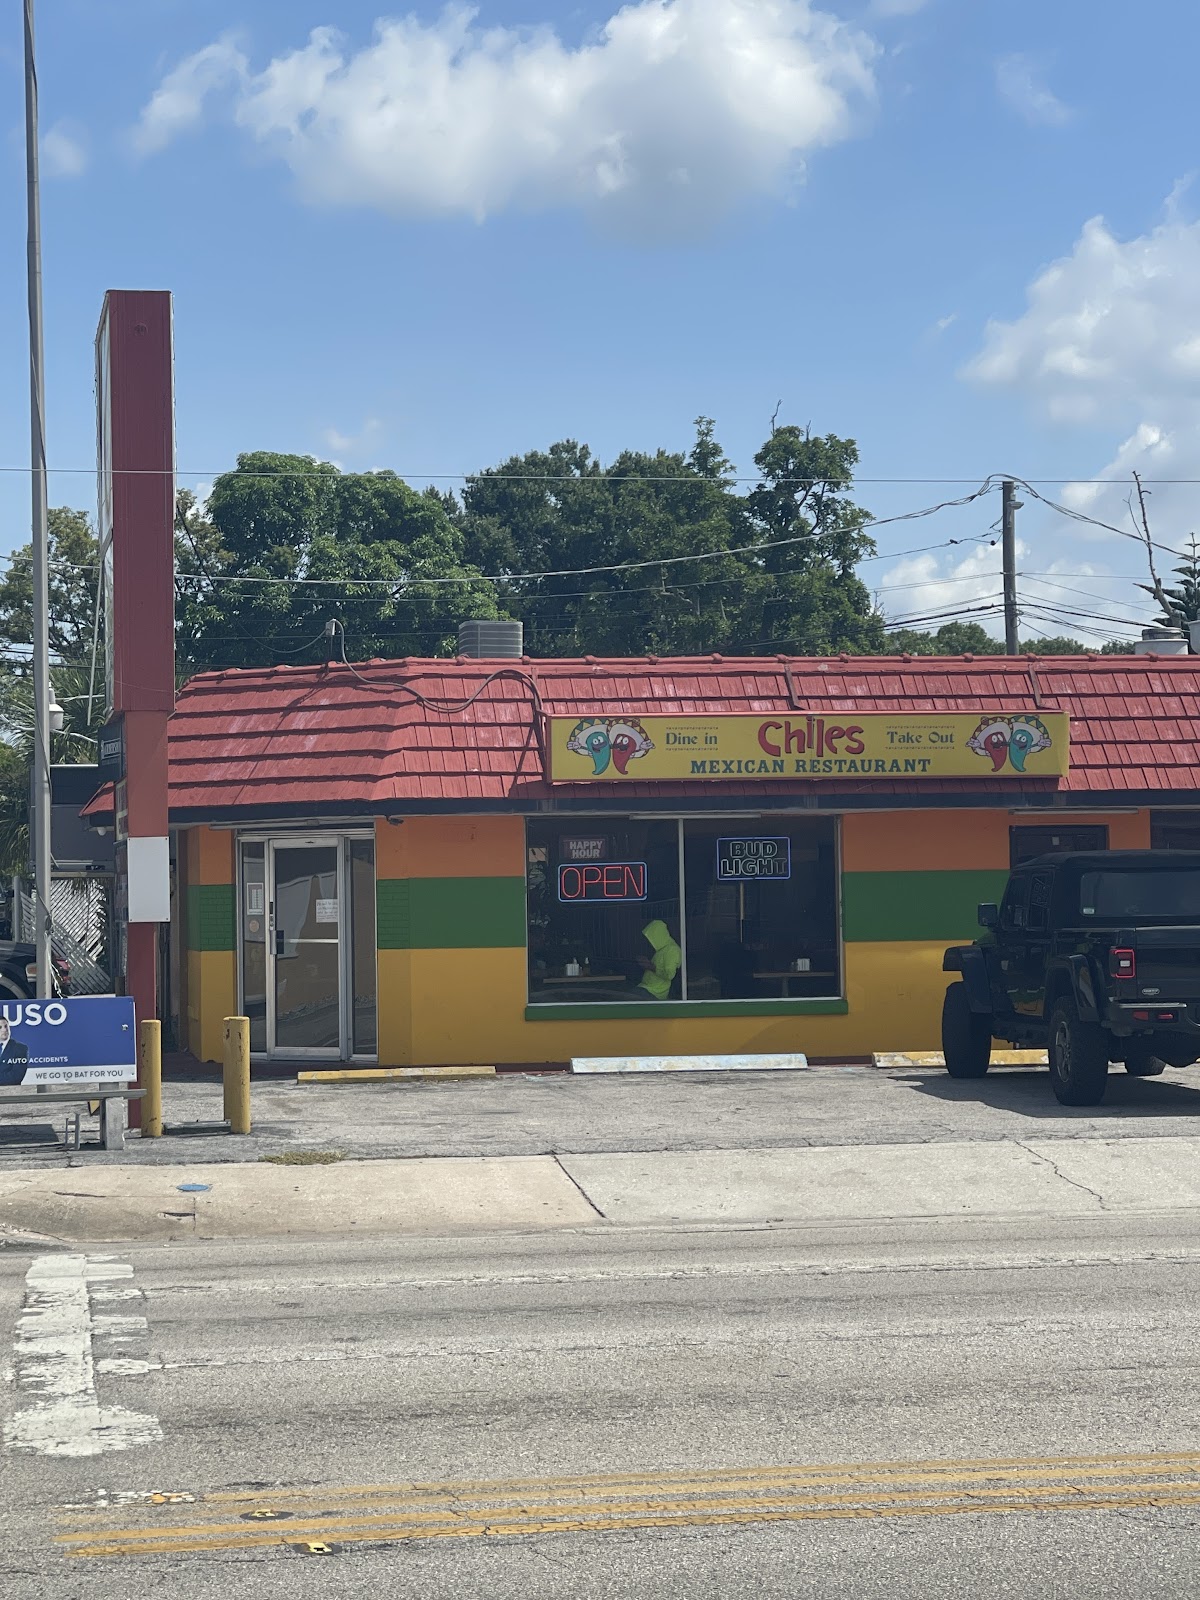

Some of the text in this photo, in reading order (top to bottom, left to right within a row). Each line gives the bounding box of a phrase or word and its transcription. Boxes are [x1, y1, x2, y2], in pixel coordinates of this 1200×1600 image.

[665, 731, 718, 746] Dine in
[757, 715, 865, 757] Chiles
[886, 731, 955, 744] Take Out
[690, 758, 931, 774] MEXICAN RESTAURANT
[569, 840, 603, 850] HAPPY
[729, 841, 778, 858] BUD
[572, 849, 600, 859] HOUR
[720, 858, 788, 876] LIGHT
[561, 866, 643, 898] OPEN
[7, 1056, 69, 1065] AUTO ACCIDENTS
[35, 1072, 48, 1080] WE
[49, 1071, 61, 1079] GO
[62, 1071, 73, 1079] TO
[89, 1070, 106, 1078] FOR
[106, 1069, 124, 1077] YOU
